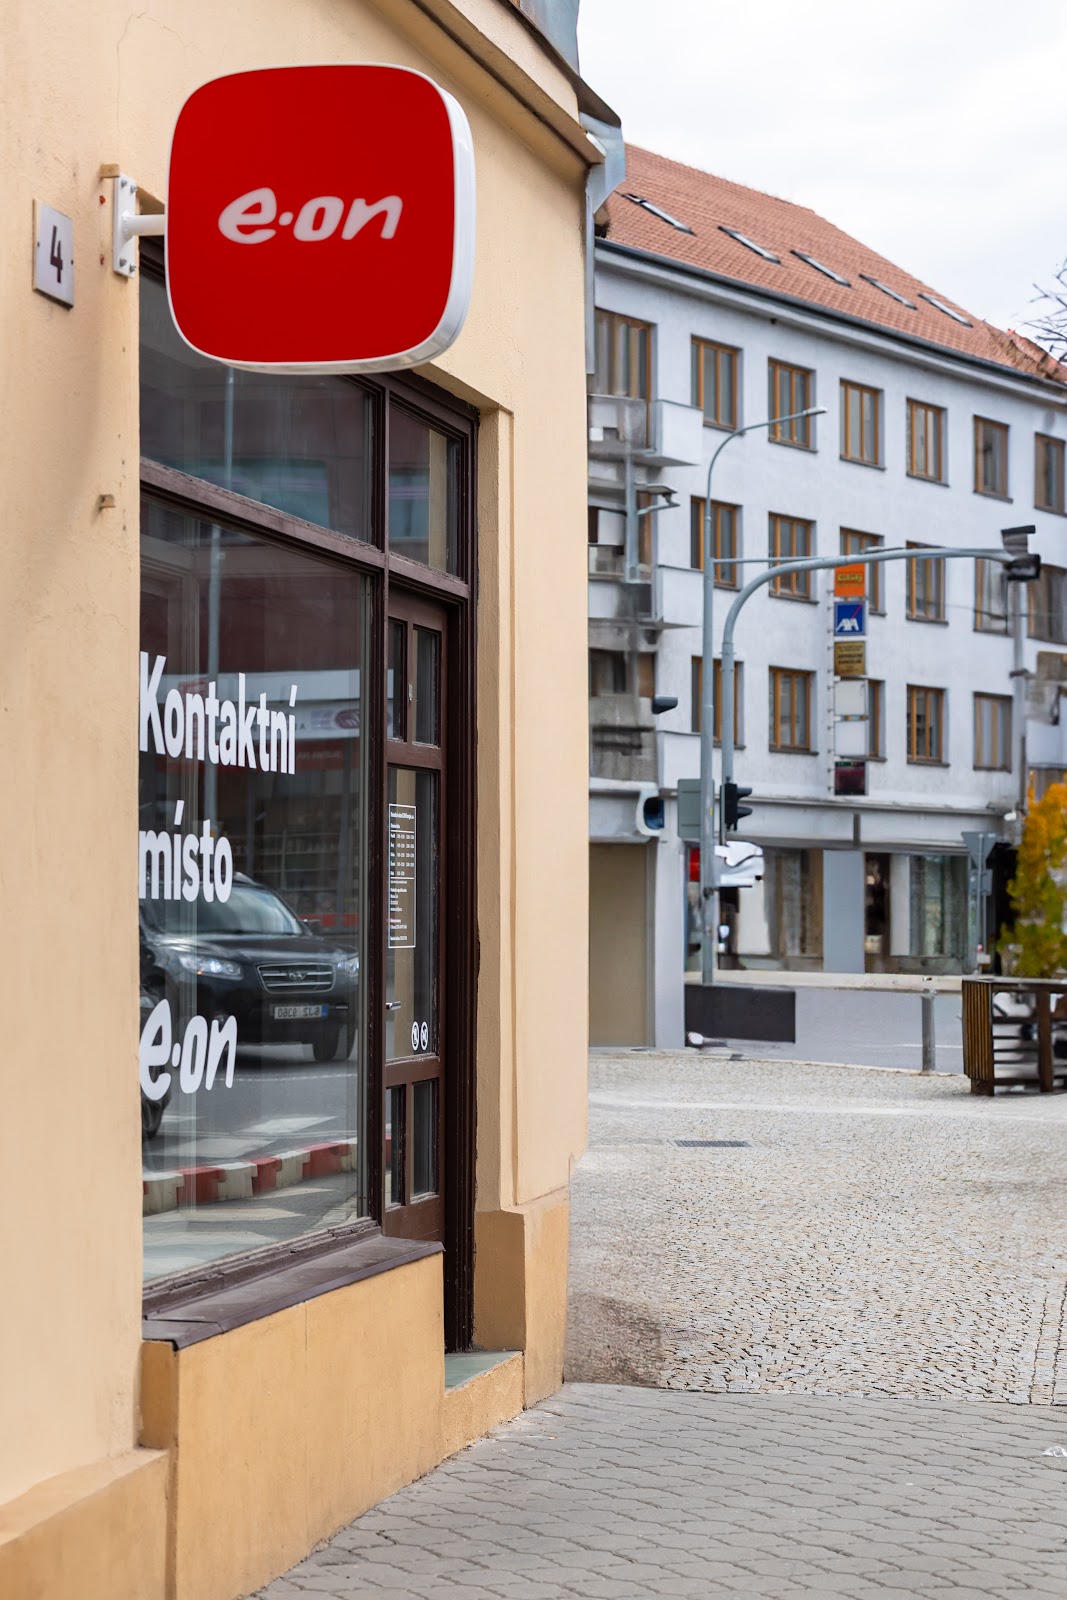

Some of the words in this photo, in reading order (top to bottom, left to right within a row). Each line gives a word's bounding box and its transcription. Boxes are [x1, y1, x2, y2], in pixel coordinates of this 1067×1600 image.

[50, 225, 63, 284] 4
[836, 617, 860, 632] AXA
[139, 651, 298, 775] Kontaktní
[138, 799, 233, 904] místo
